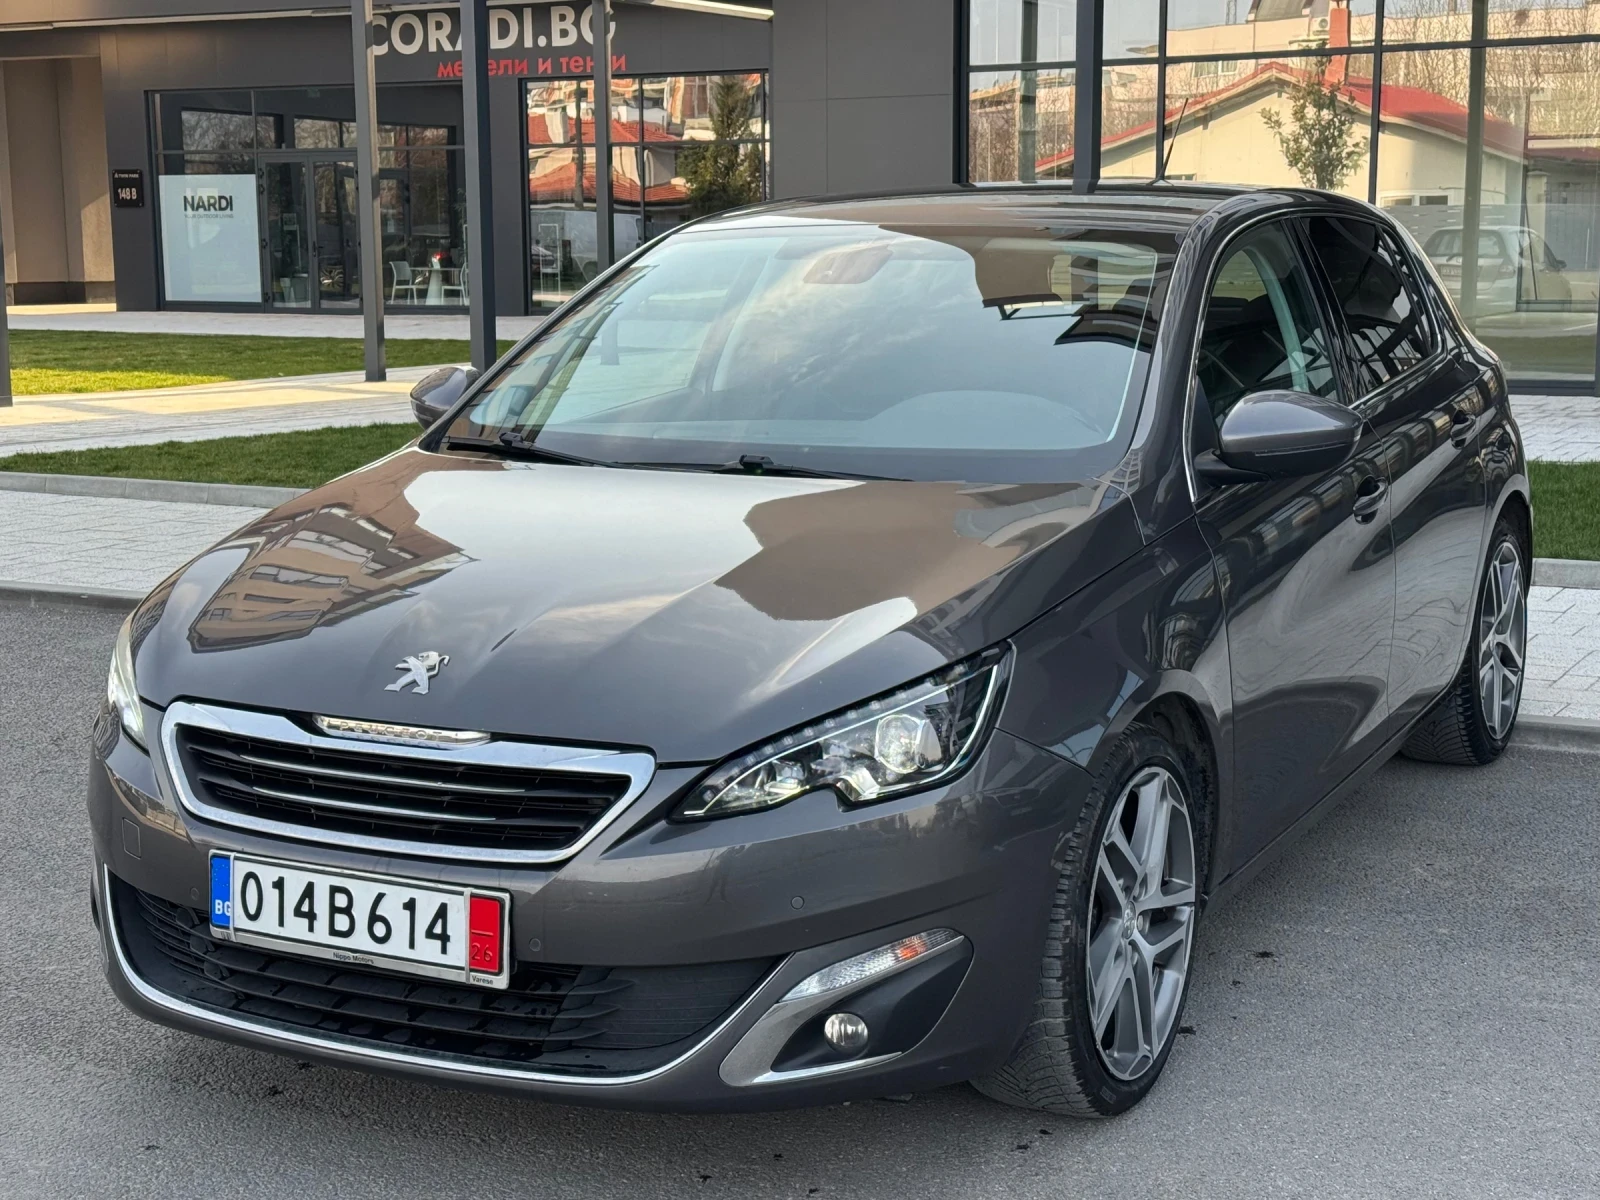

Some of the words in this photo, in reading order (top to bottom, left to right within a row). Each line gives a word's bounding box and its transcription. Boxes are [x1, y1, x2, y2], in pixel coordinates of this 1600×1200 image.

[437, 58, 528, 78] меели
[538, 56, 552, 74] и
[560, 54, 626, 73] тени
[183, 195, 233, 212] NARDI
[339, 720, 443, 742] PEUGEOT
[215, 899, 231, 917] BG
[240, 871, 451, 955] 014B614
[332, 951, 351, 961] Nippo
[352, 954, 375, 965] Motors
[470, 942, 493, 962] 26
[471, 975, 494, 985] Varese
